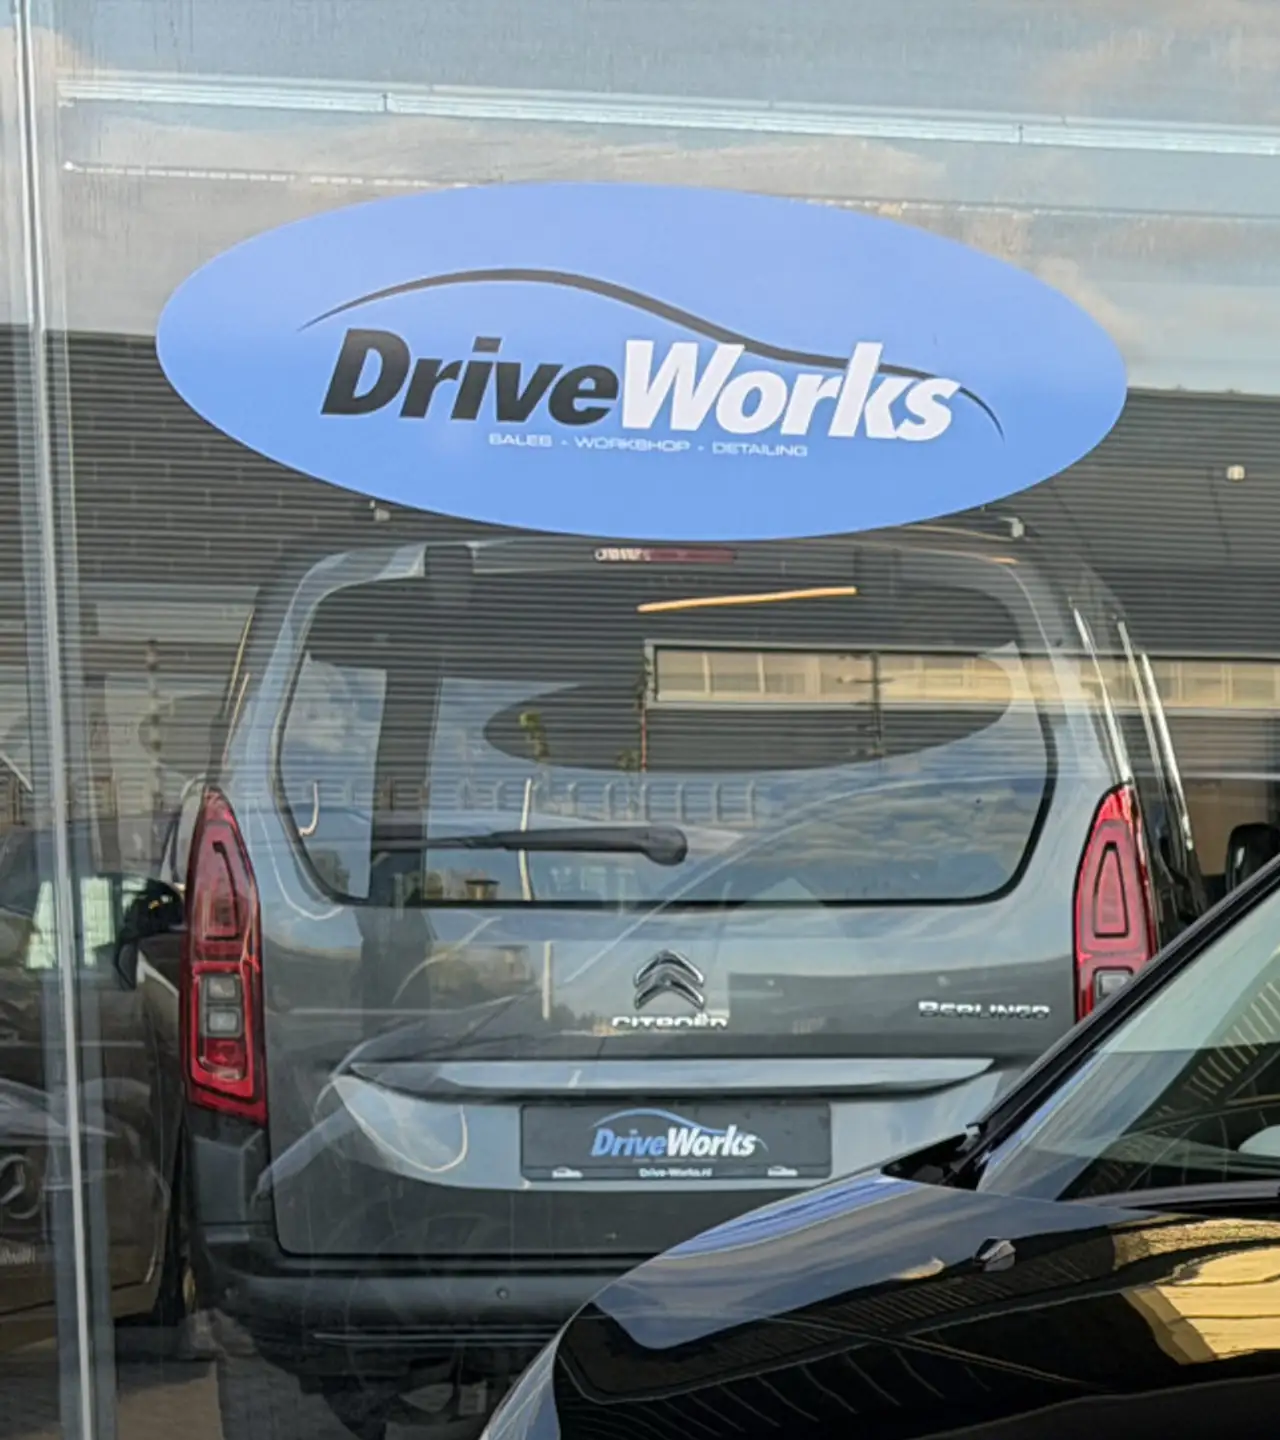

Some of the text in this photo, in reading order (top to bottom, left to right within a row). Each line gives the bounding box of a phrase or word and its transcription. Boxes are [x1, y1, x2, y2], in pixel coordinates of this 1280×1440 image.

[320, 325, 962, 441] DriveWorks
[489, 433, 807, 456] SALES WORKSHOP DETAILING
[590, 1124, 757, 1157] DriveWorks
